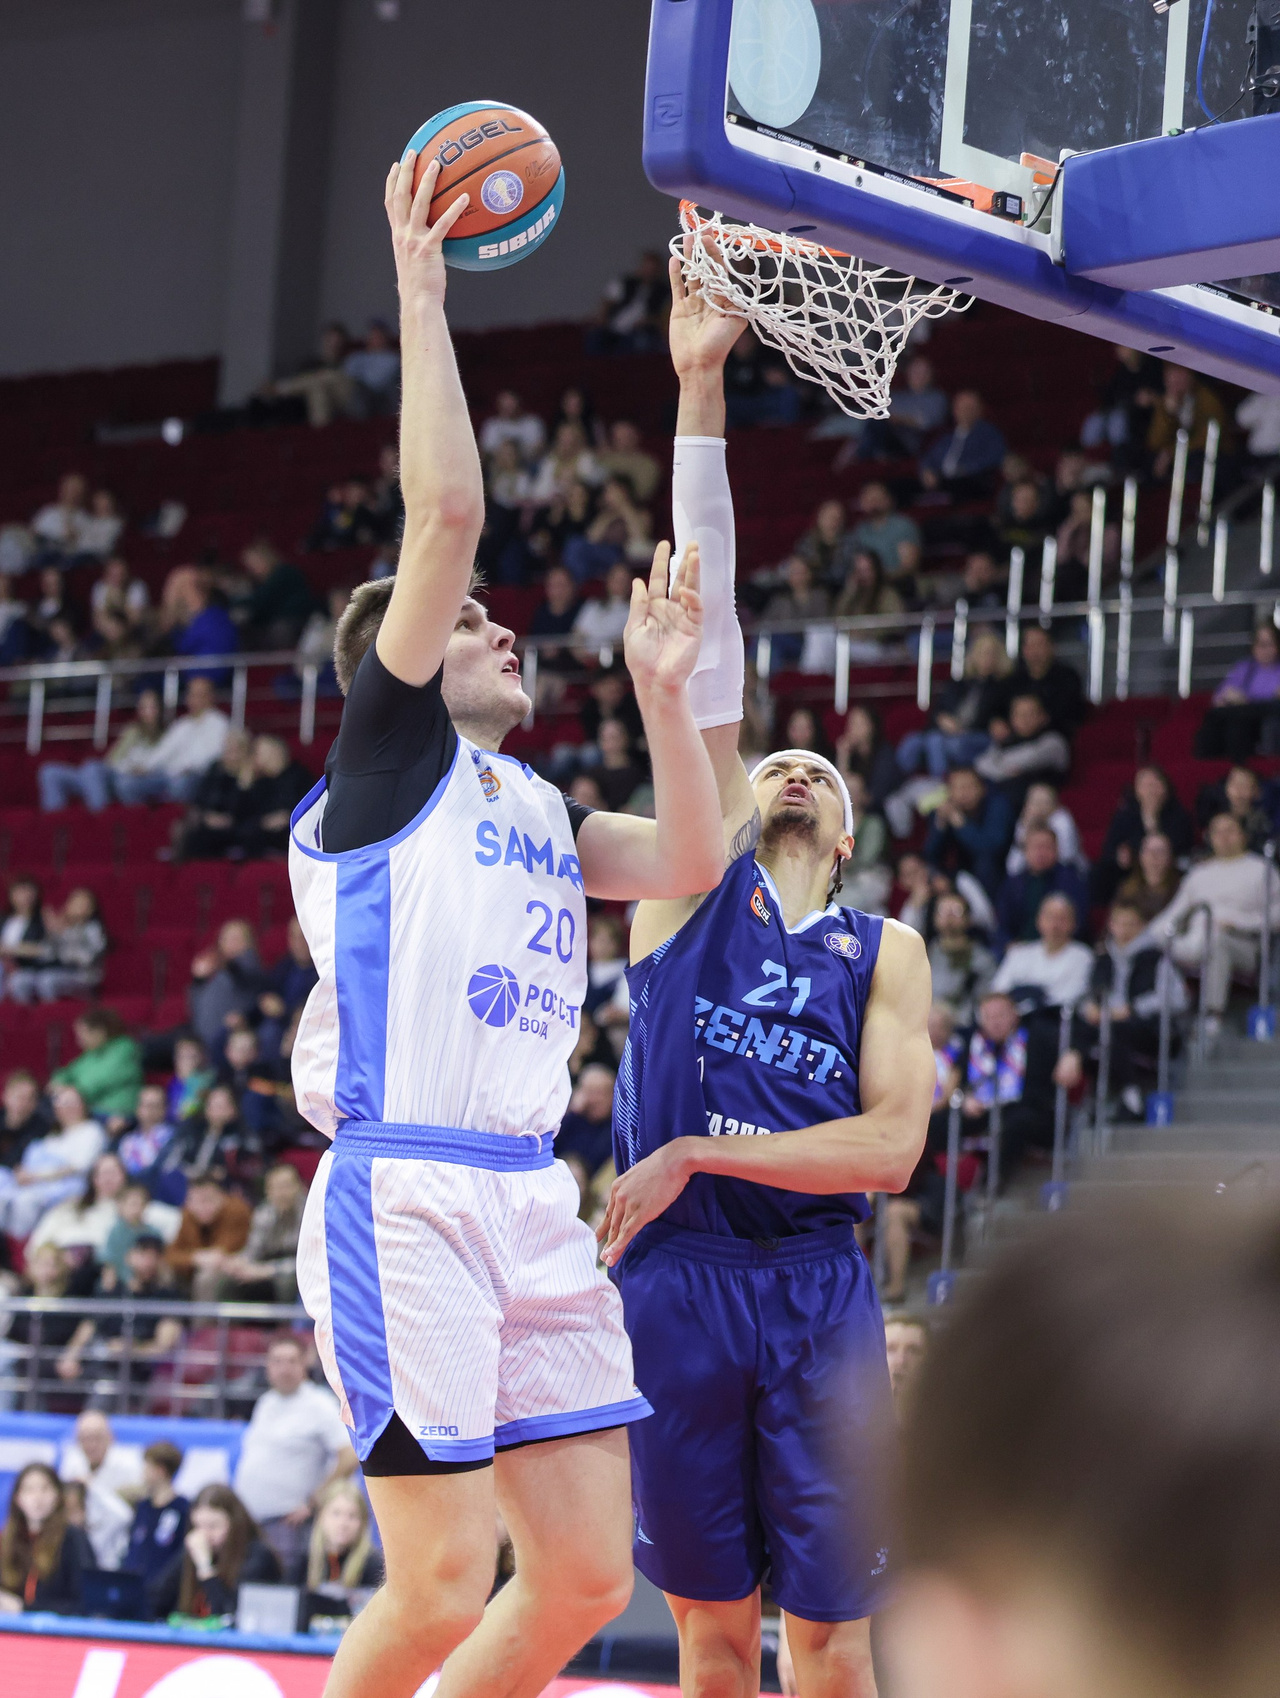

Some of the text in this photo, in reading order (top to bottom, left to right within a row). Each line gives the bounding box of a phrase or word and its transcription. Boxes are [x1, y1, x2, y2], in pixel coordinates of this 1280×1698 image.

[435, 119, 524, 175] ÖGEL
[526, 900, 575, 964] 20
[741, 959, 812, 1018] 21
[419, 1425, 459, 1437] ZEDO
